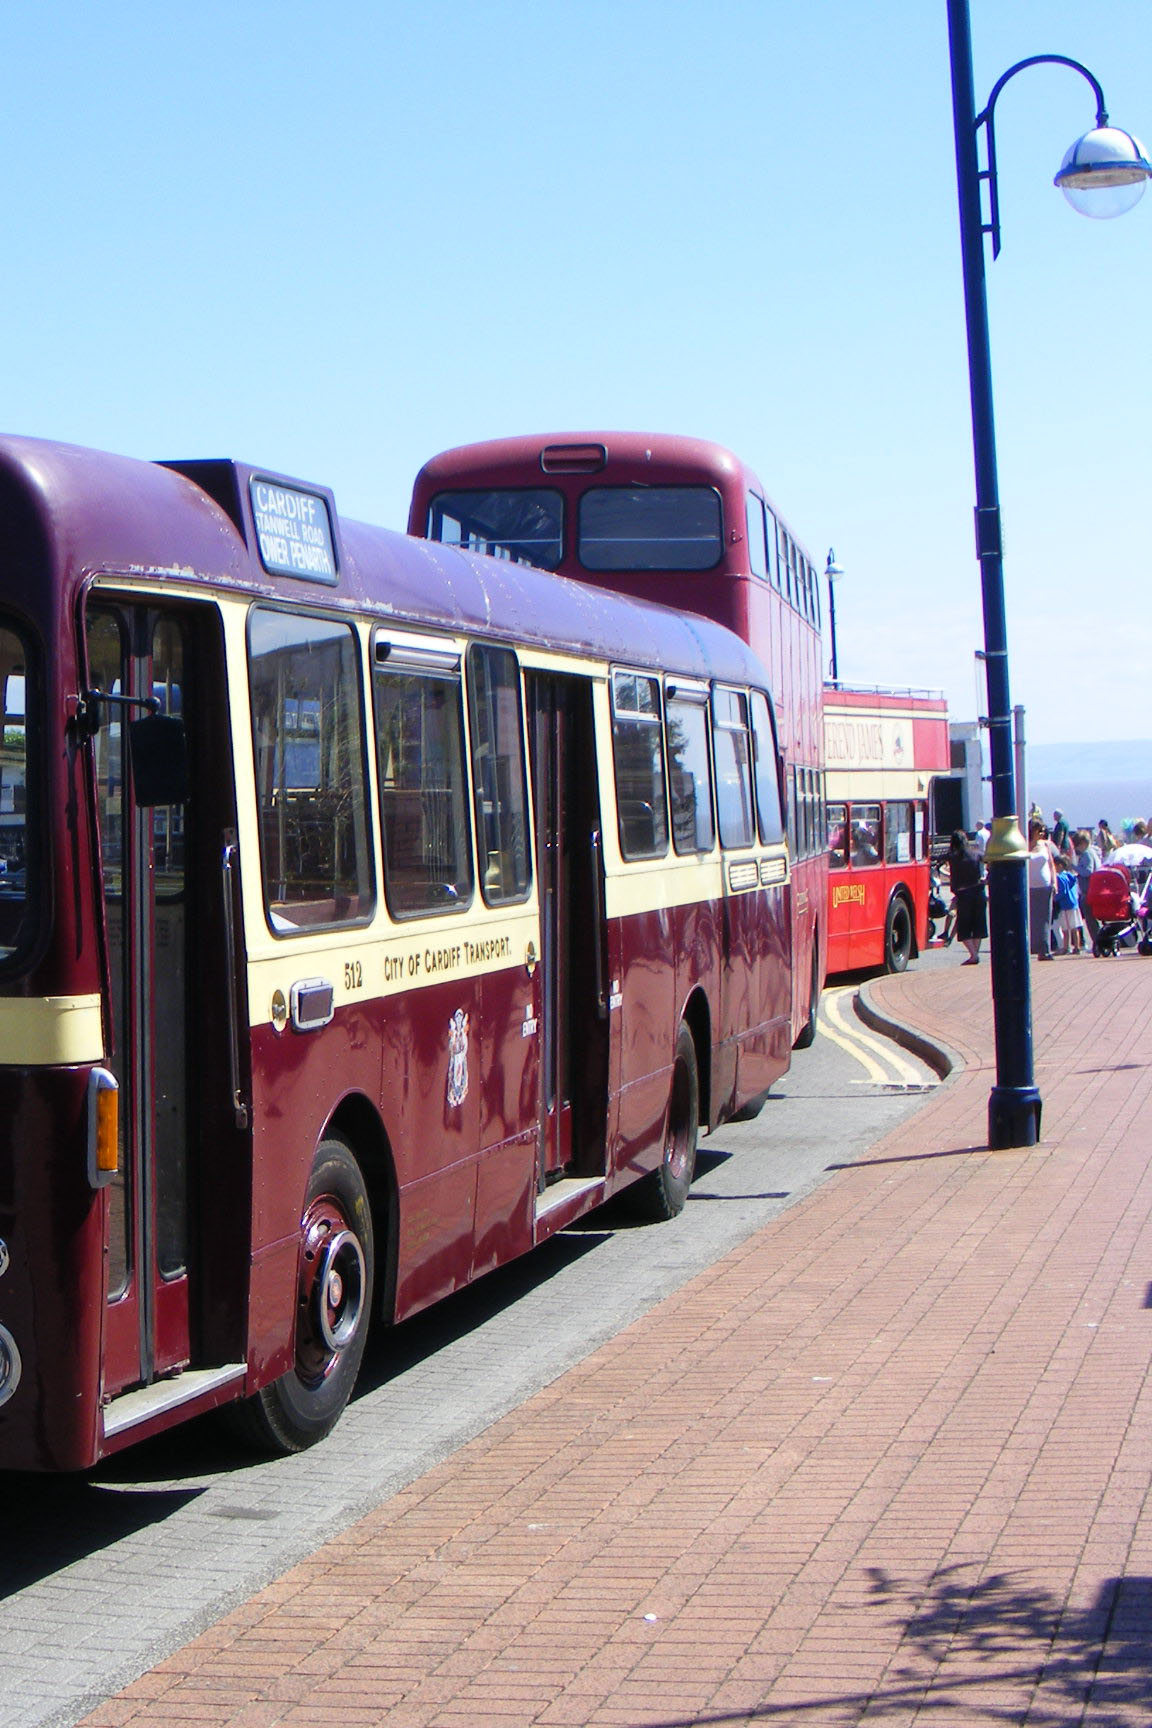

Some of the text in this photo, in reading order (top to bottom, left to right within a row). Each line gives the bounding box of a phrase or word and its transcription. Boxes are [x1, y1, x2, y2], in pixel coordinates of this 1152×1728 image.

[256, 486, 316, 524] CARDIFF
[301, 524, 325, 547] ROAD
[289, 540, 332, 575] PENARTH
[344, 961, 363, 990] 512
[384, 956, 404, 981] CITY
[408, 953, 421, 976] OF
[424, 946, 461, 973] CARDIFF
